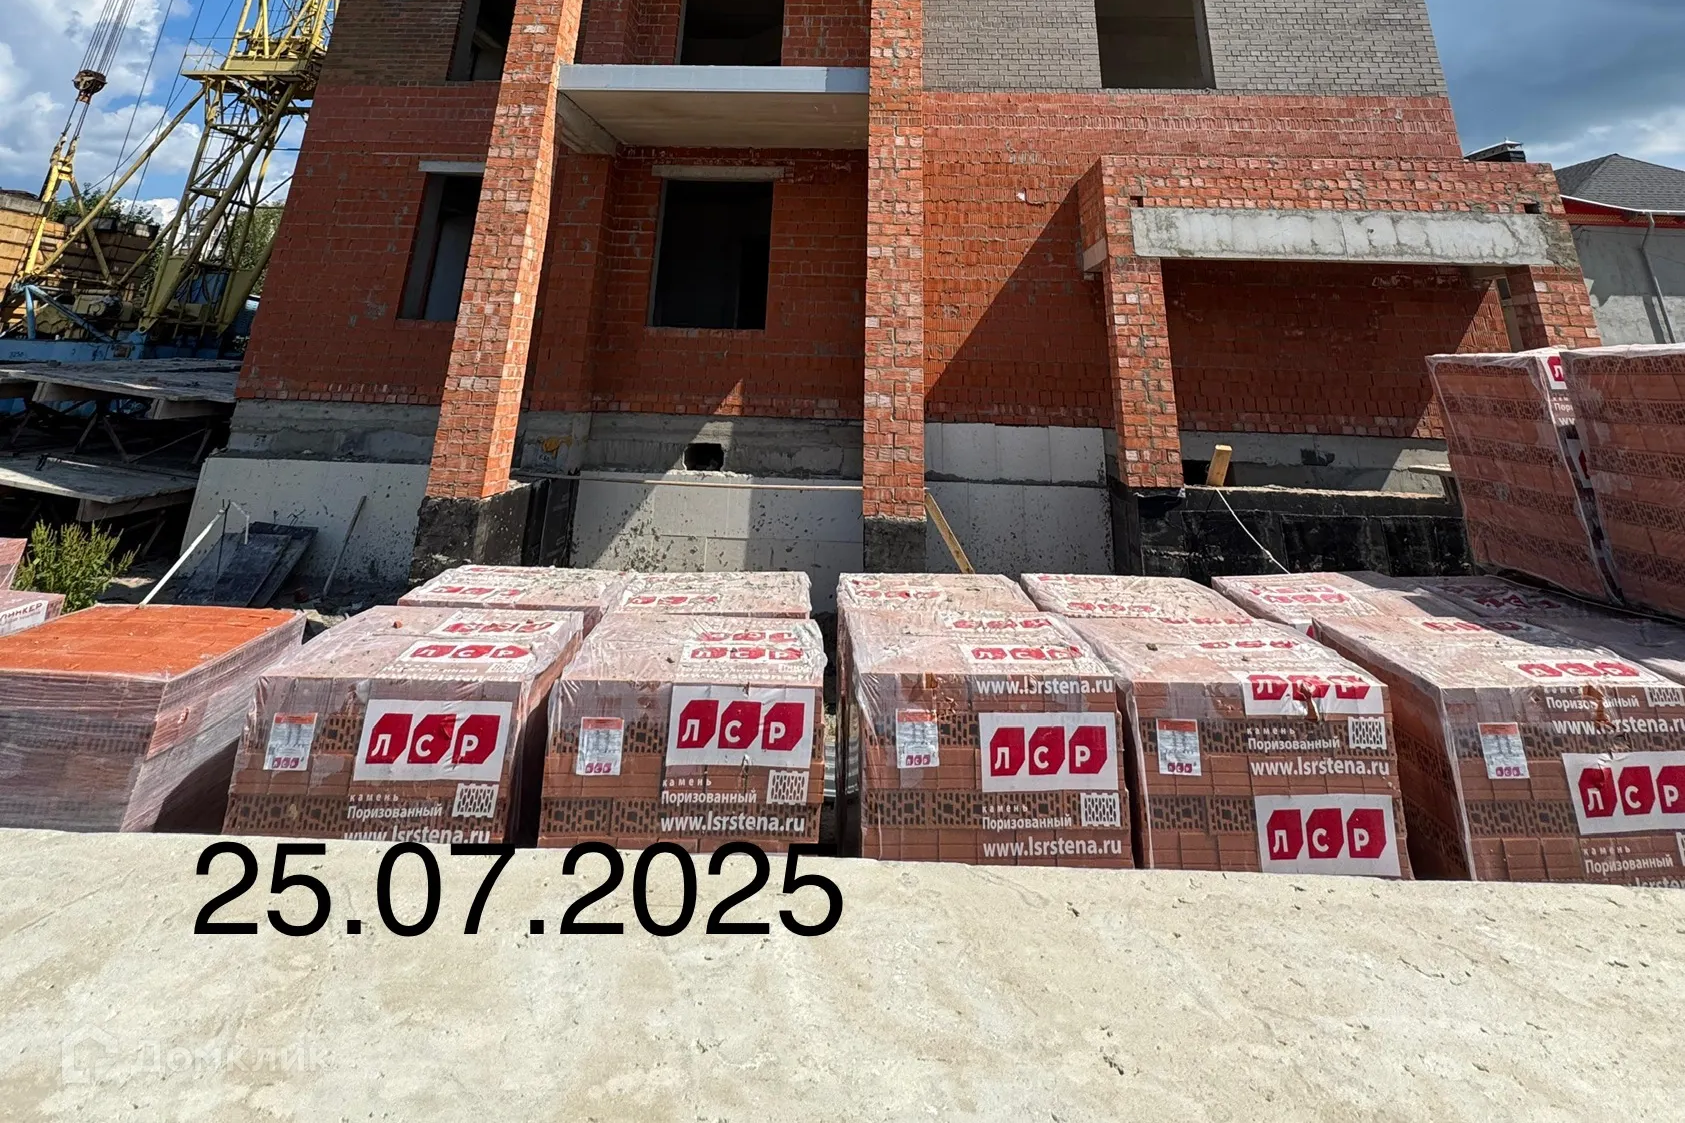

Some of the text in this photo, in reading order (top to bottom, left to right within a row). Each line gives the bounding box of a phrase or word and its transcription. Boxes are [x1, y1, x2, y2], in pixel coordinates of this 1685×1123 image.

[1246, 726, 1296, 735] камень
[1247, 735, 1341, 753] Поризованный
[1249, 756, 1390, 777] www.lsrstena.ru
[662, 778, 712, 788] камень
[349, 793, 399, 802] камень
[660, 787, 757, 807] Поризованный
[346, 803, 443, 822] Поризованный
[982, 804, 1029, 813] камень
[660, 811, 805, 832] www.lsrstena.ru
[981, 813, 1072, 832] Поризованный
[343, 825, 491, 844] wwwlsrstena.ru
[982, 836, 1122, 857] www.lsrstena.ru
[1583, 845, 1631, 856] камень
[1584, 854, 1674, 876] Поризованный
